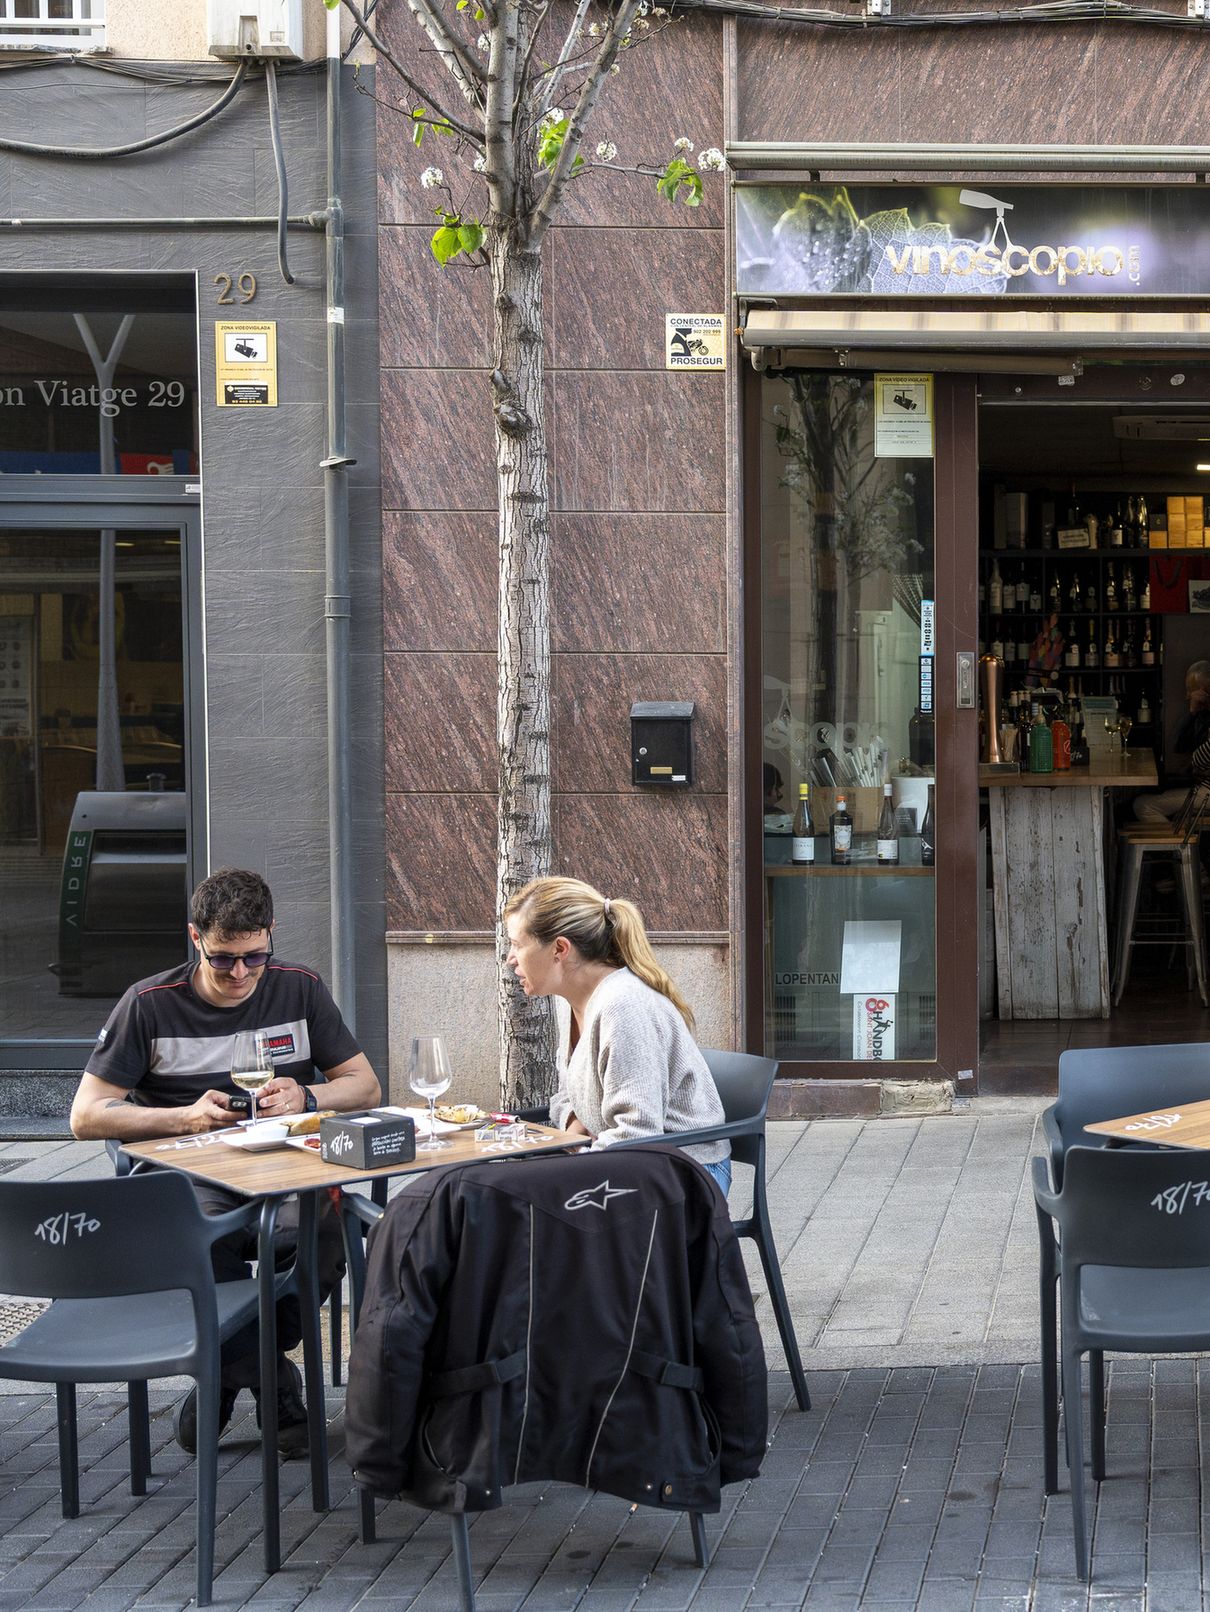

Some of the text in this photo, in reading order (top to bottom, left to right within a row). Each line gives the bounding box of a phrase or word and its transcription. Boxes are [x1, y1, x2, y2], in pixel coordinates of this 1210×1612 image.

[213, 272, 257, 305] 29
[670, 357, 723, 365] PROSEGUR
[0, 380, 185, 417] n Viatge 29
[331, 1131, 354, 1156] 18/70
[34, 1212, 101, 1246] 18/70
